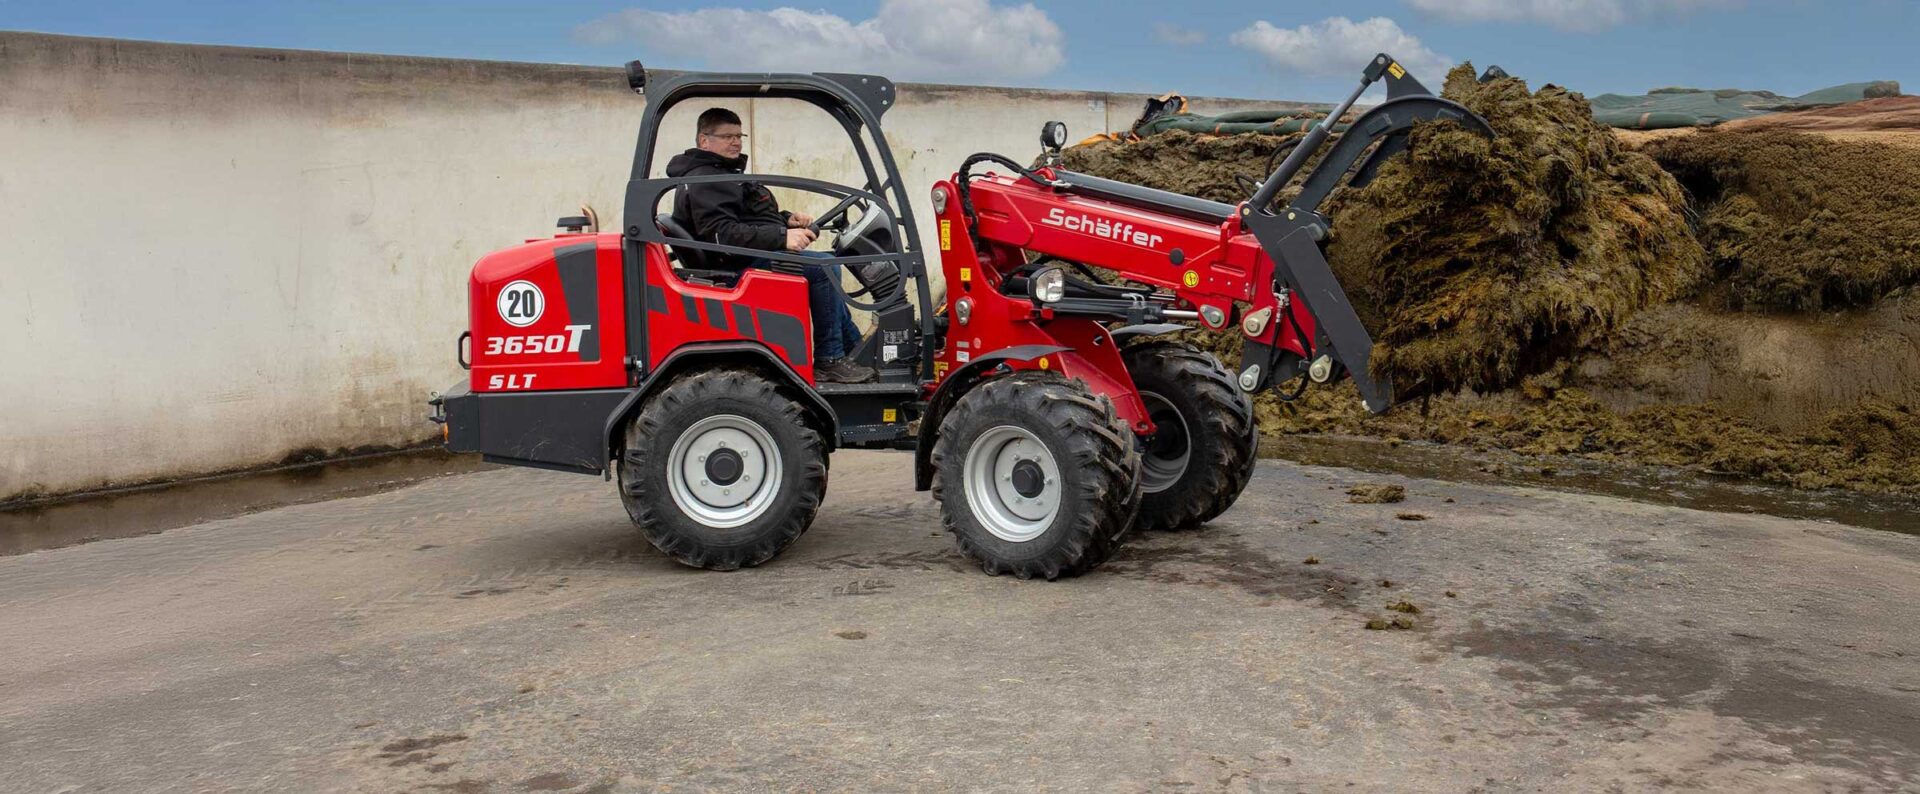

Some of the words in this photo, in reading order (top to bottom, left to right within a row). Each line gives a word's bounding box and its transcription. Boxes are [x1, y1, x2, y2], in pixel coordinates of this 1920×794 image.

[1041, 207, 1163, 248] Schäffer
[507, 289, 535, 318] 20
[485, 325, 591, 355] 3650T
[488, 373, 537, 389] SLT
